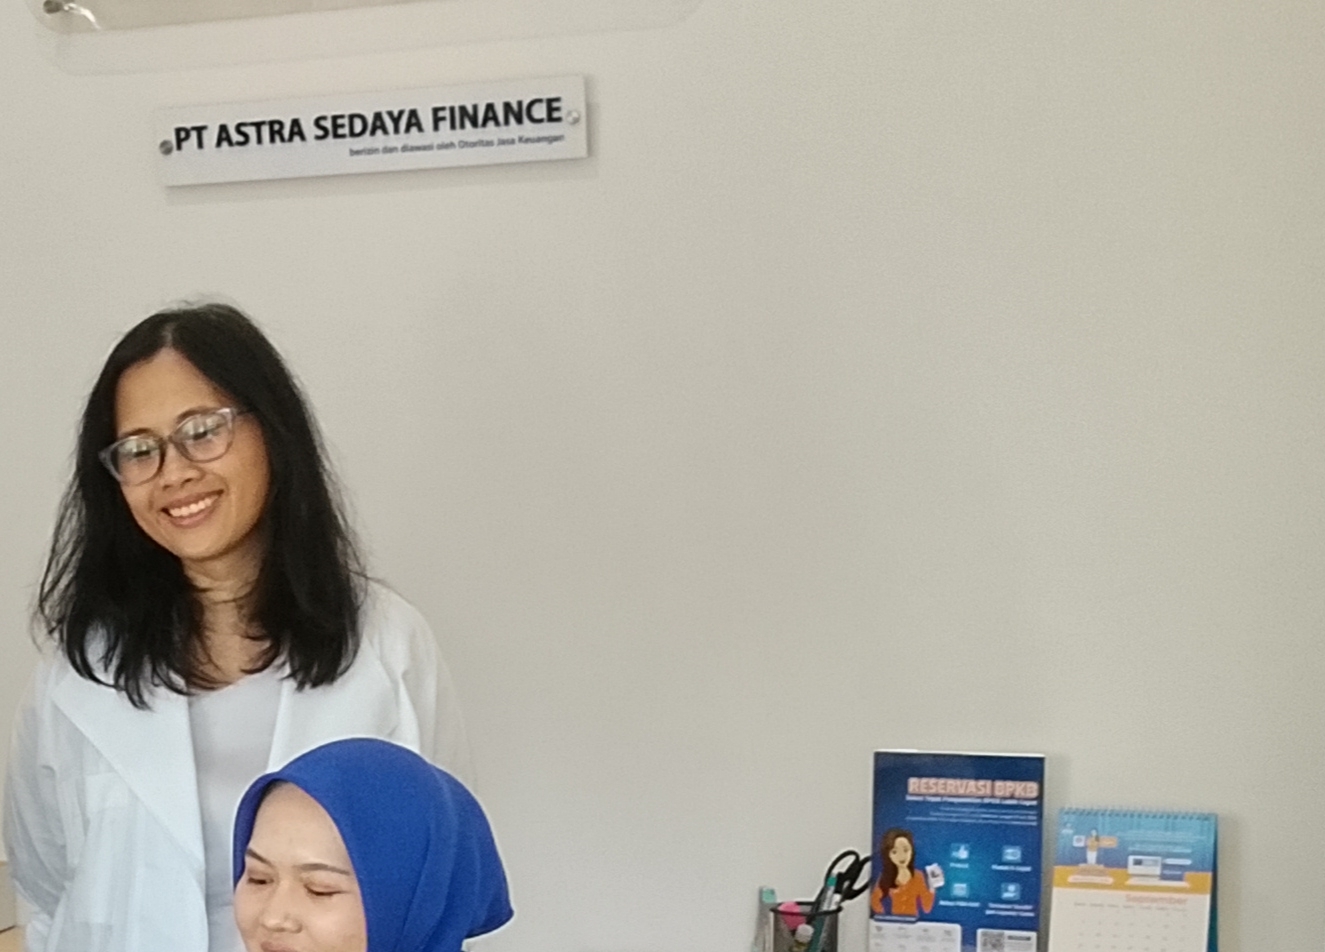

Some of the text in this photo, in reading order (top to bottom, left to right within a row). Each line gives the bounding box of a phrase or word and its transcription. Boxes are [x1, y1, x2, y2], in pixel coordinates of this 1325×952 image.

[174, 97, 563, 151] PT ASTRA SEDAYA FINANCE
[349, 133, 565, 156] berizin dan diawasi oleh Otoritas Jasa Keuangan
[907, 777, 1039, 799] RESERVASI BPKB
